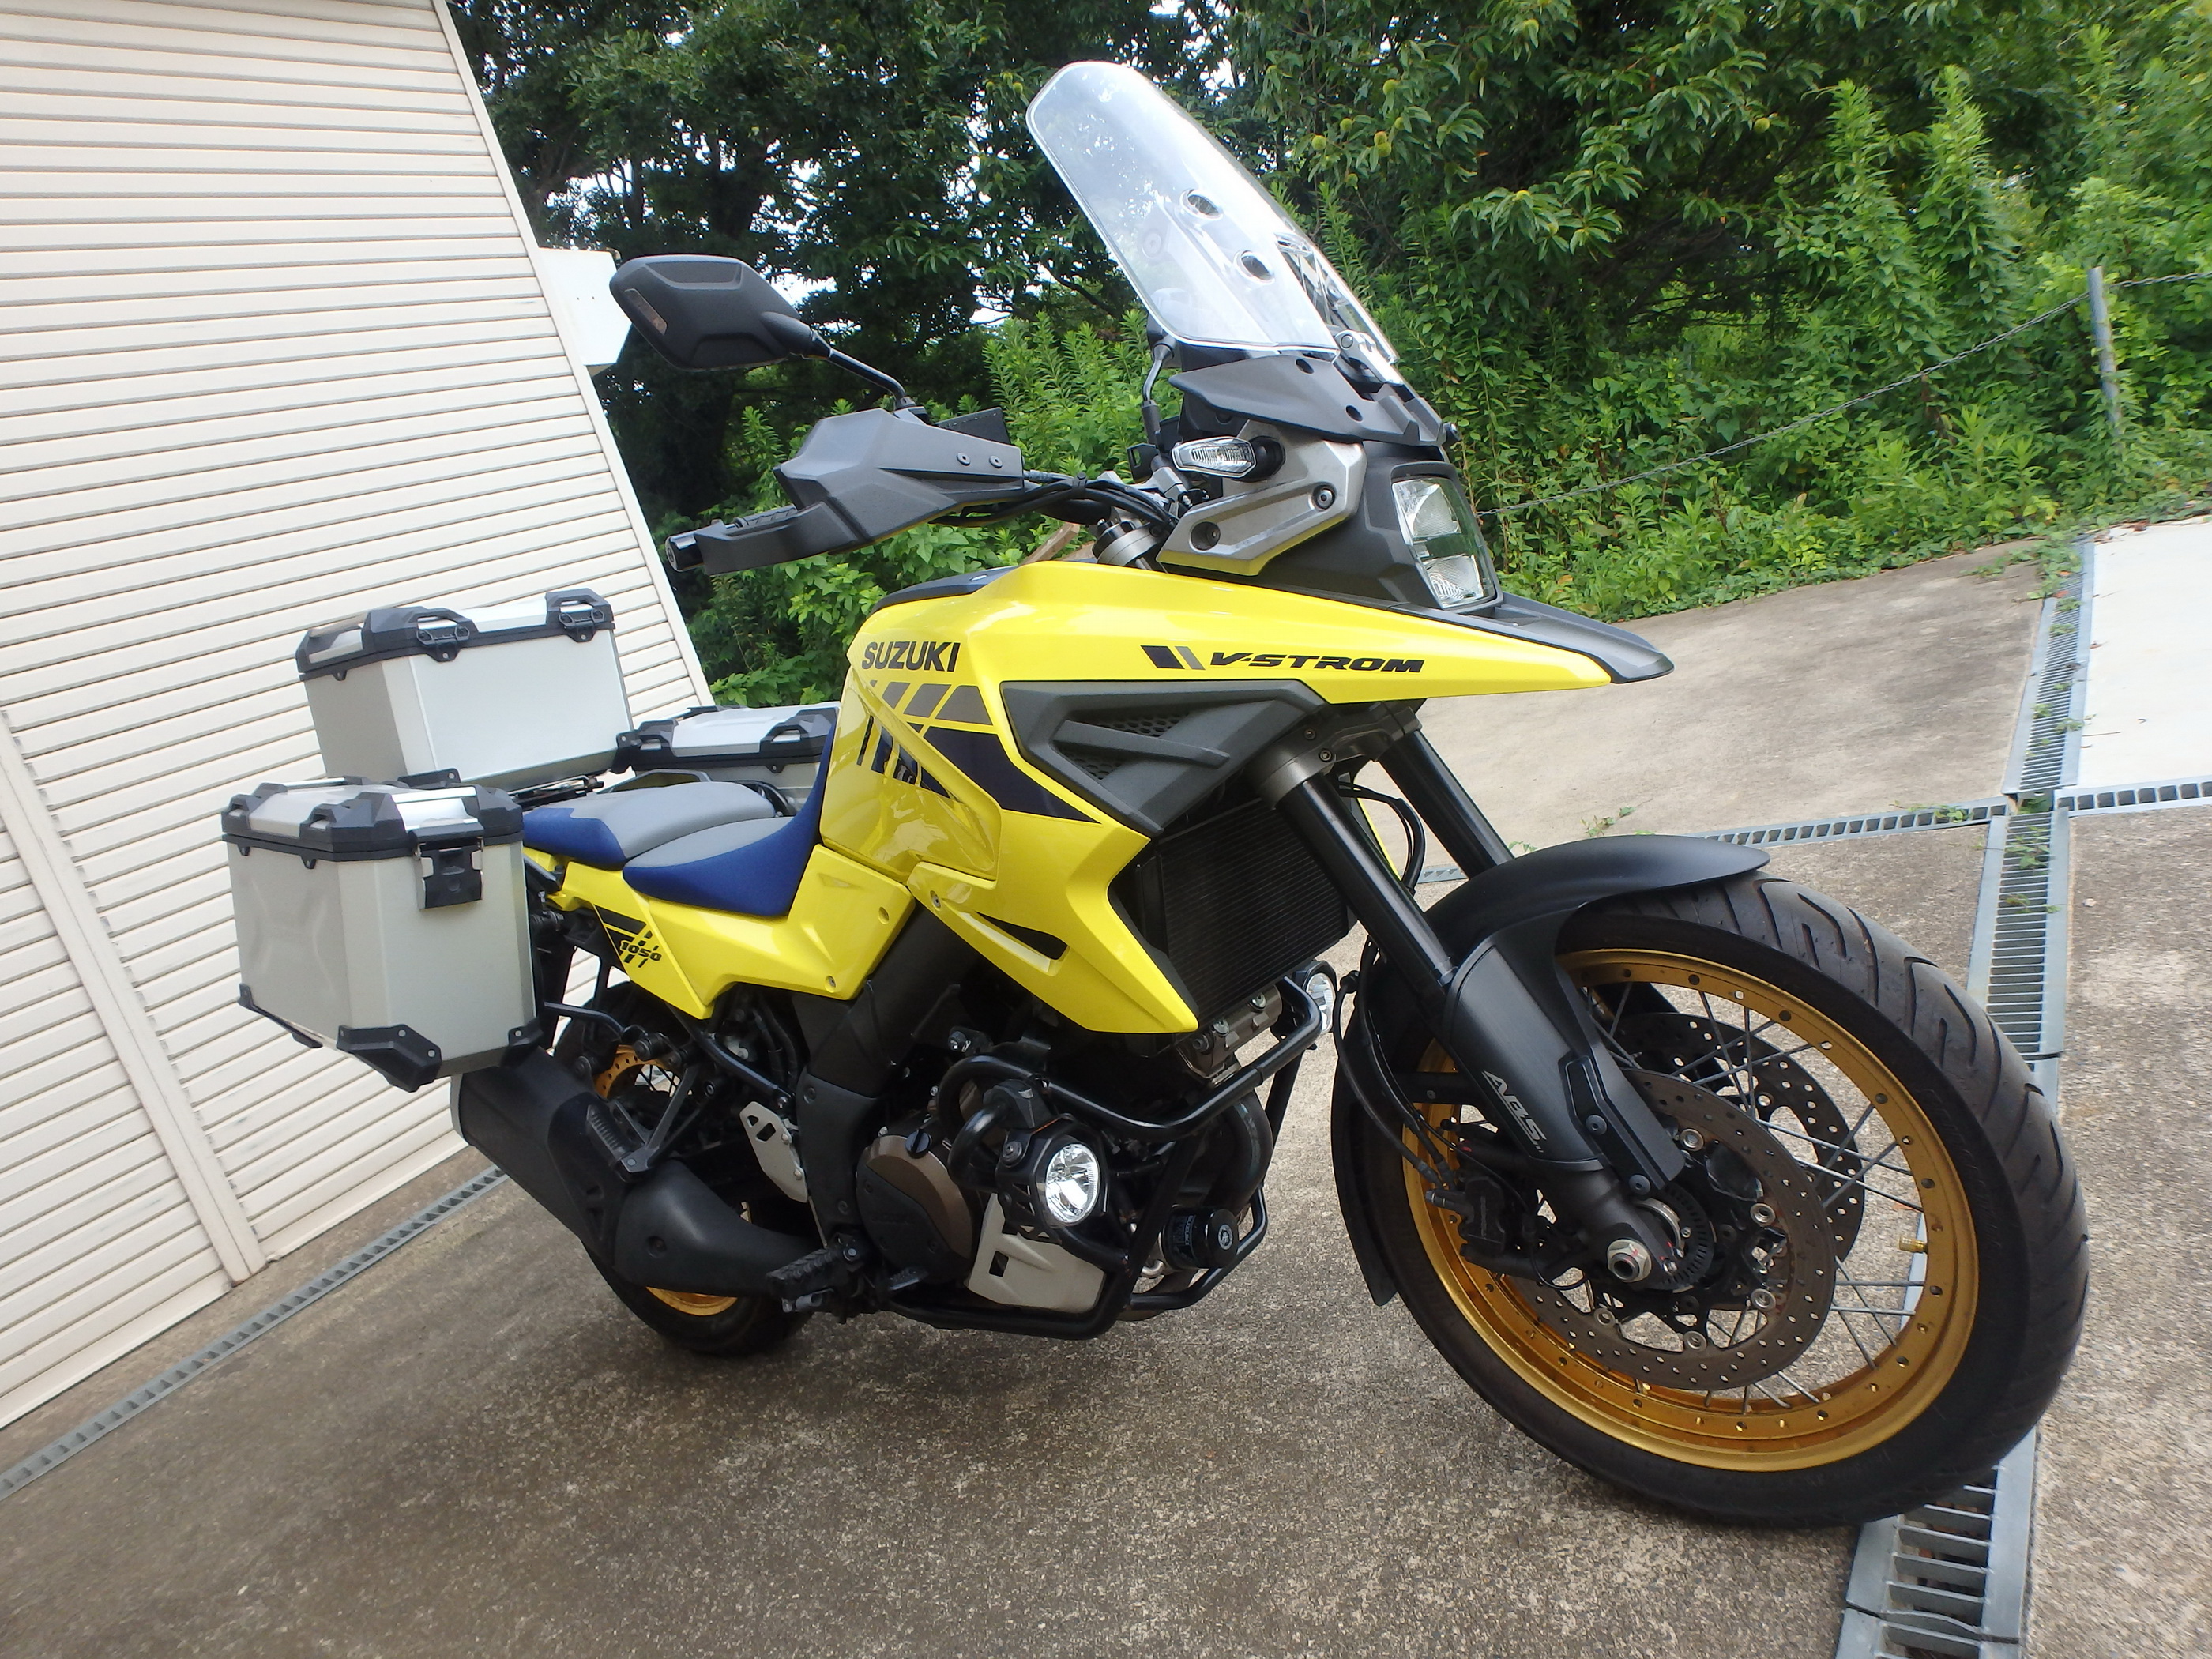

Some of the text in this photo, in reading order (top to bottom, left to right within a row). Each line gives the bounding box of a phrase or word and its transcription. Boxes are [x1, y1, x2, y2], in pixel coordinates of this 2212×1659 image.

[862, 641, 961, 672] SUZUKI
[1209, 652, 1425, 672] V-STROM
[620, 940, 662, 961] 1050
[1482, 1070, 1547, 1142] ABS
